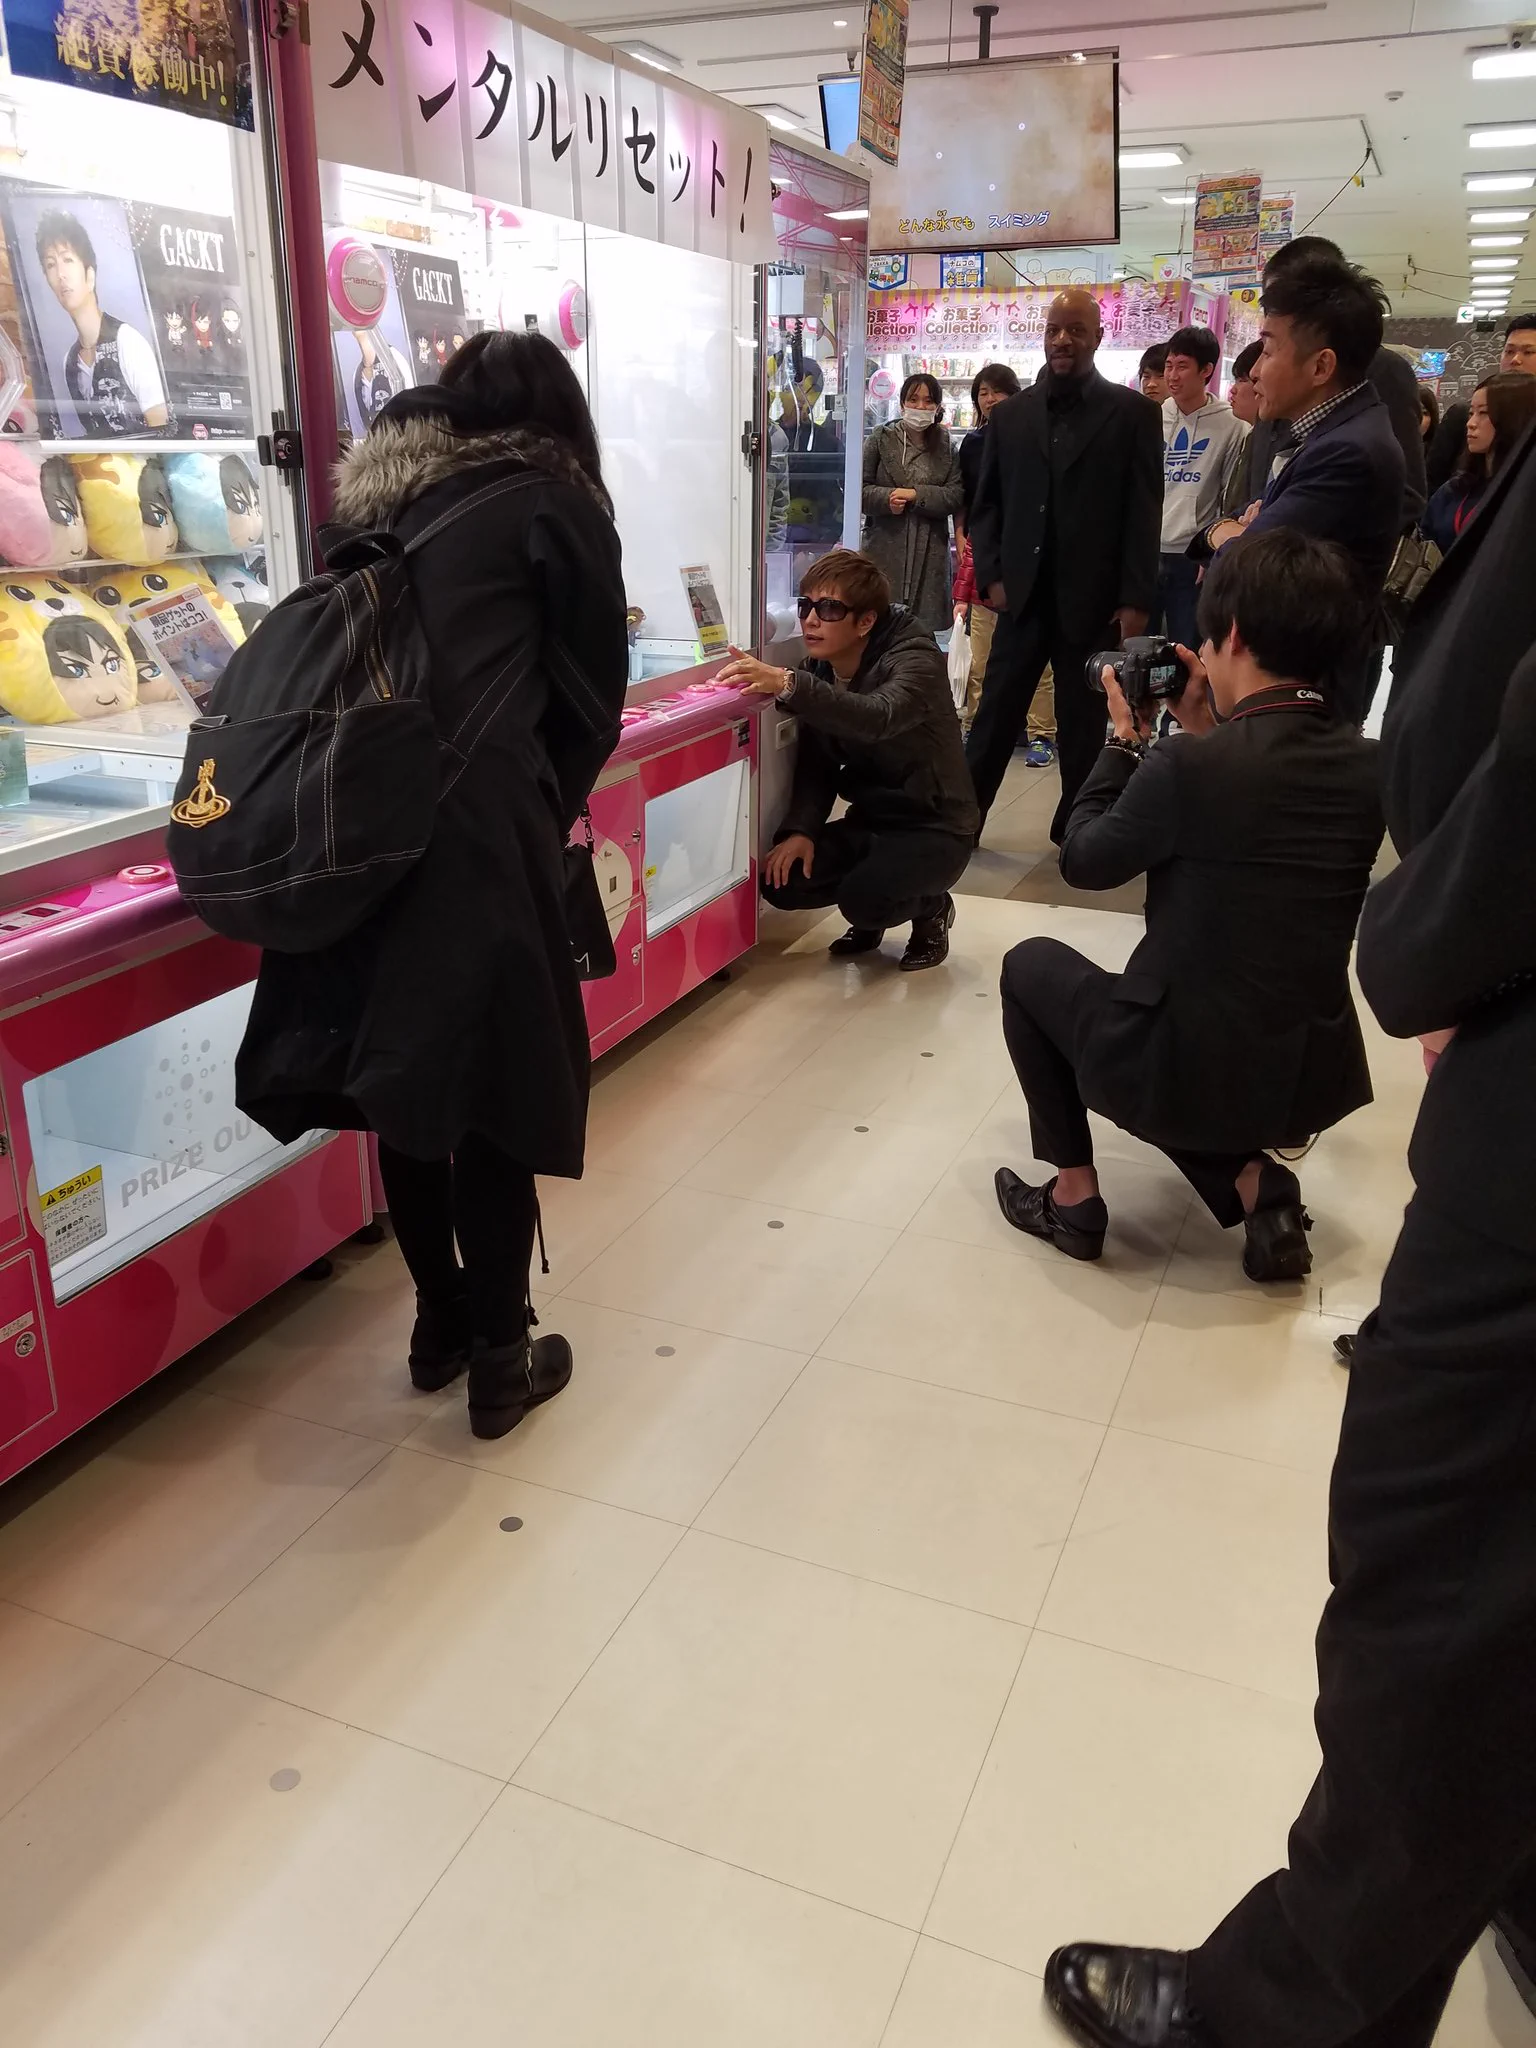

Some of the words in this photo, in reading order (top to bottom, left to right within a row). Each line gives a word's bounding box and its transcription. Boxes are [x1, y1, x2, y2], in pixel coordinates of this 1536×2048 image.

[329, 0, 753, 234] メンタルリセット!
[899, 216, 975, 233] どんな水でも
[989, 211, 1050, 228] スイミング
[160, 223, 224, 273] GACKT
[412, 267, 454, 305] GACKT
[945, 269, 979, 287] 雑貨
[943, 307, 981, 321] お菓子
[867, 322, 916, 336] llection
[925, 321, 997, 334] Collection
[1008, 320, 1045, 333] Colle
[1164, 468, 1201, 483] didas
[120, 1140, 205, 1208] PRIZE
[213, 1117, 263, 1153] OU
[58, 1175, 91, 1199] ちゅうい
